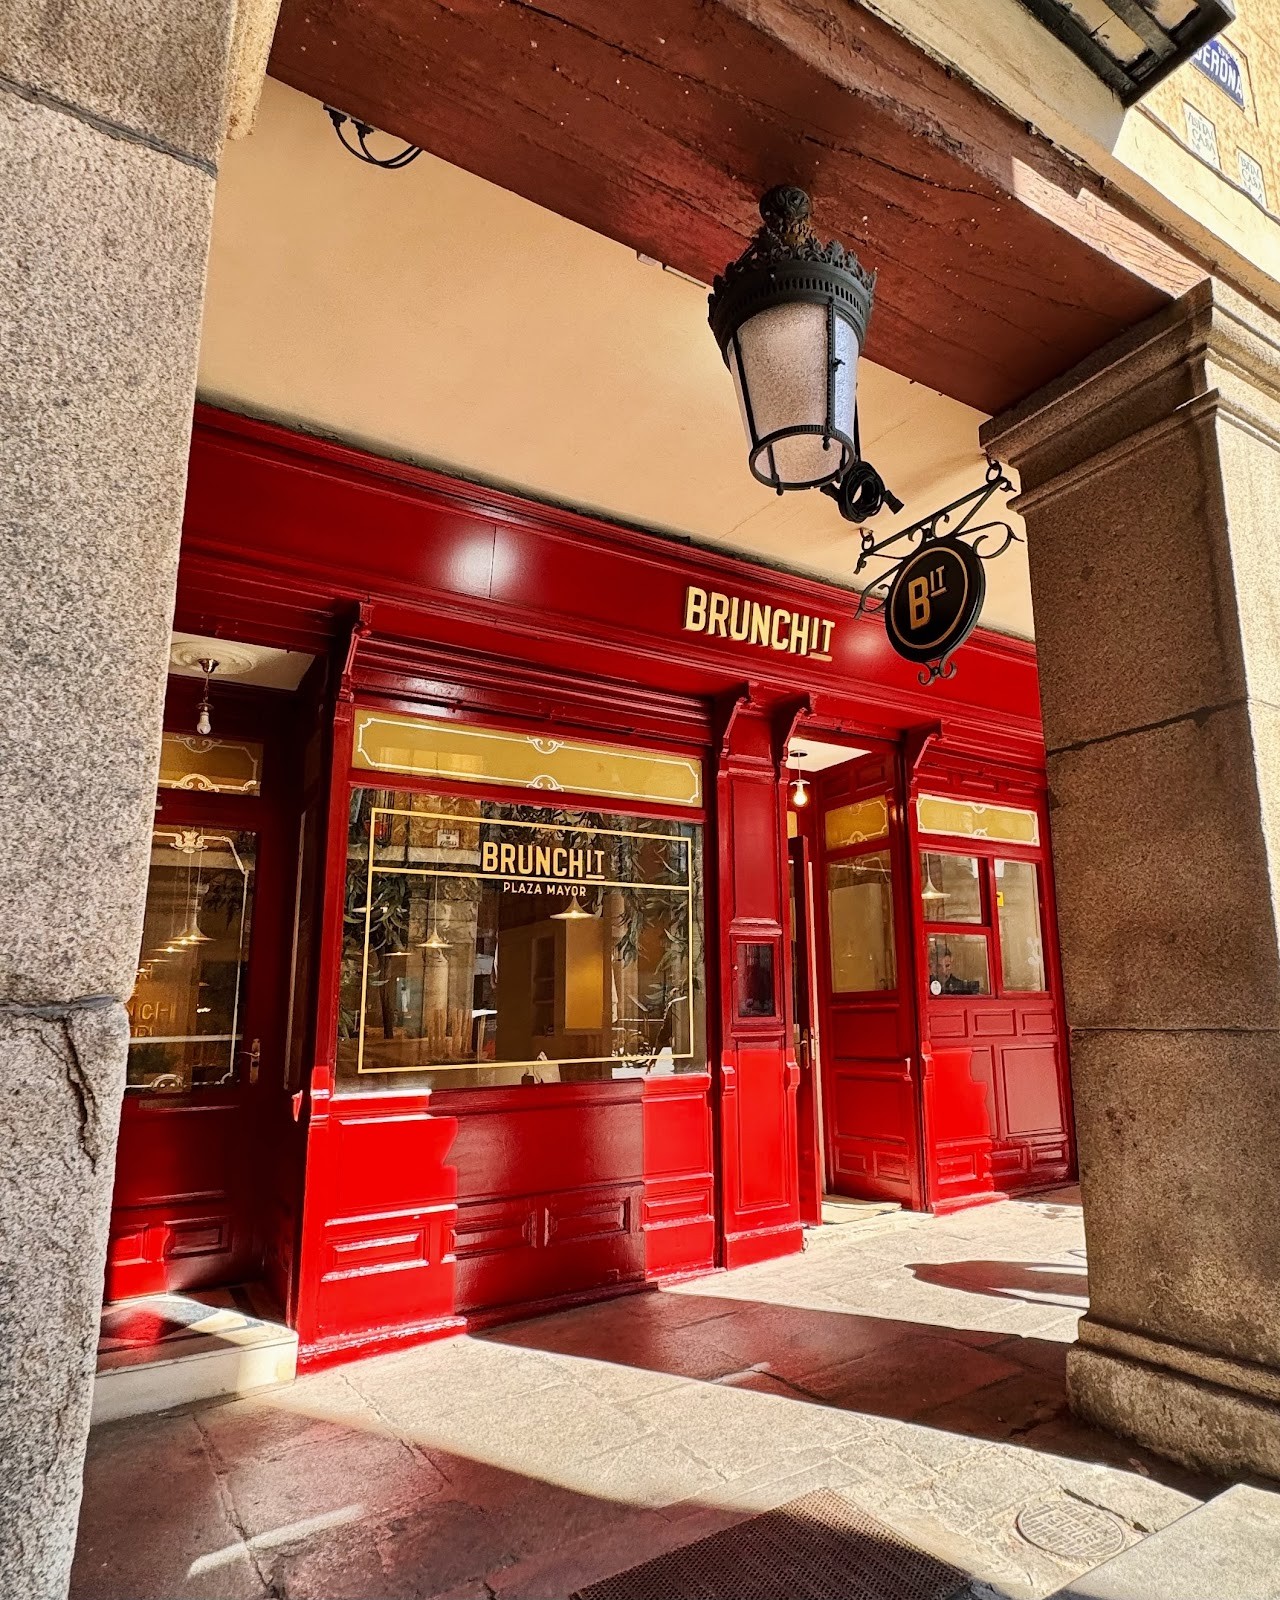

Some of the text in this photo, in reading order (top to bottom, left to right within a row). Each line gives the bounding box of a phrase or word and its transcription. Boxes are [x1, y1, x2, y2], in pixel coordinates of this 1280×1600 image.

[685, 585, 836, 661] BRUNCHIT
[482, 841, 605, 879] BRUNCHIT
[503, 881, 587, 897] PLAZA MAYOR
